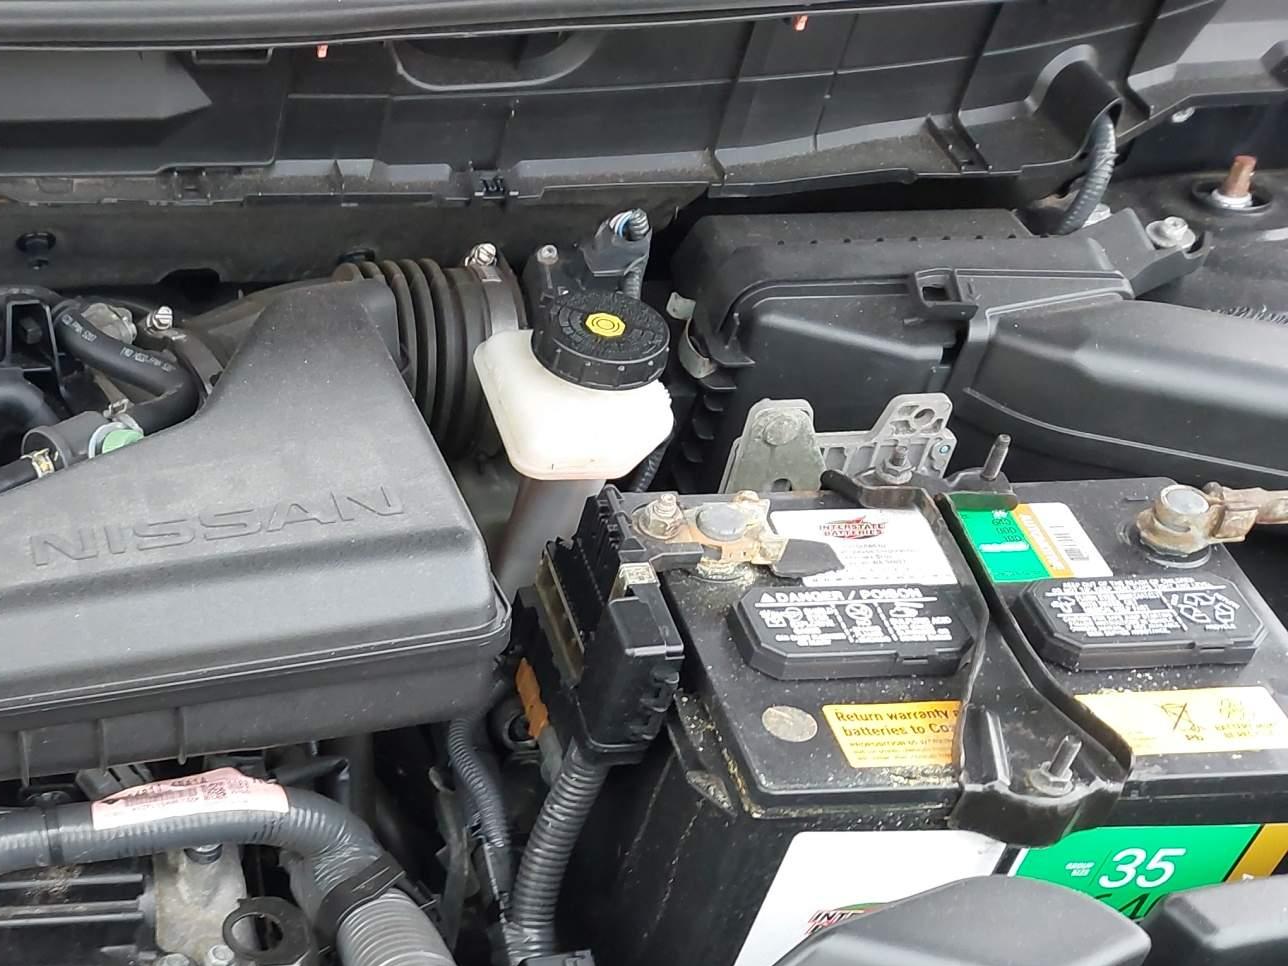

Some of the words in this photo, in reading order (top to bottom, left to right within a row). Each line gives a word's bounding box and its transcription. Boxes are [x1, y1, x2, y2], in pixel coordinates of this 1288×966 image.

[30, 485, 404, 566] NISSAN
[776, 591, 845, 603] DANGER
[859, 588, 923, 600] POISON
[835, 710, 882, 722] Return
[887, 709, 949, 720] warranty
[842, 726, 908, 736] batteries
[911, 724, 925, 734] to
[1098, 848, 1186, 888] 35
